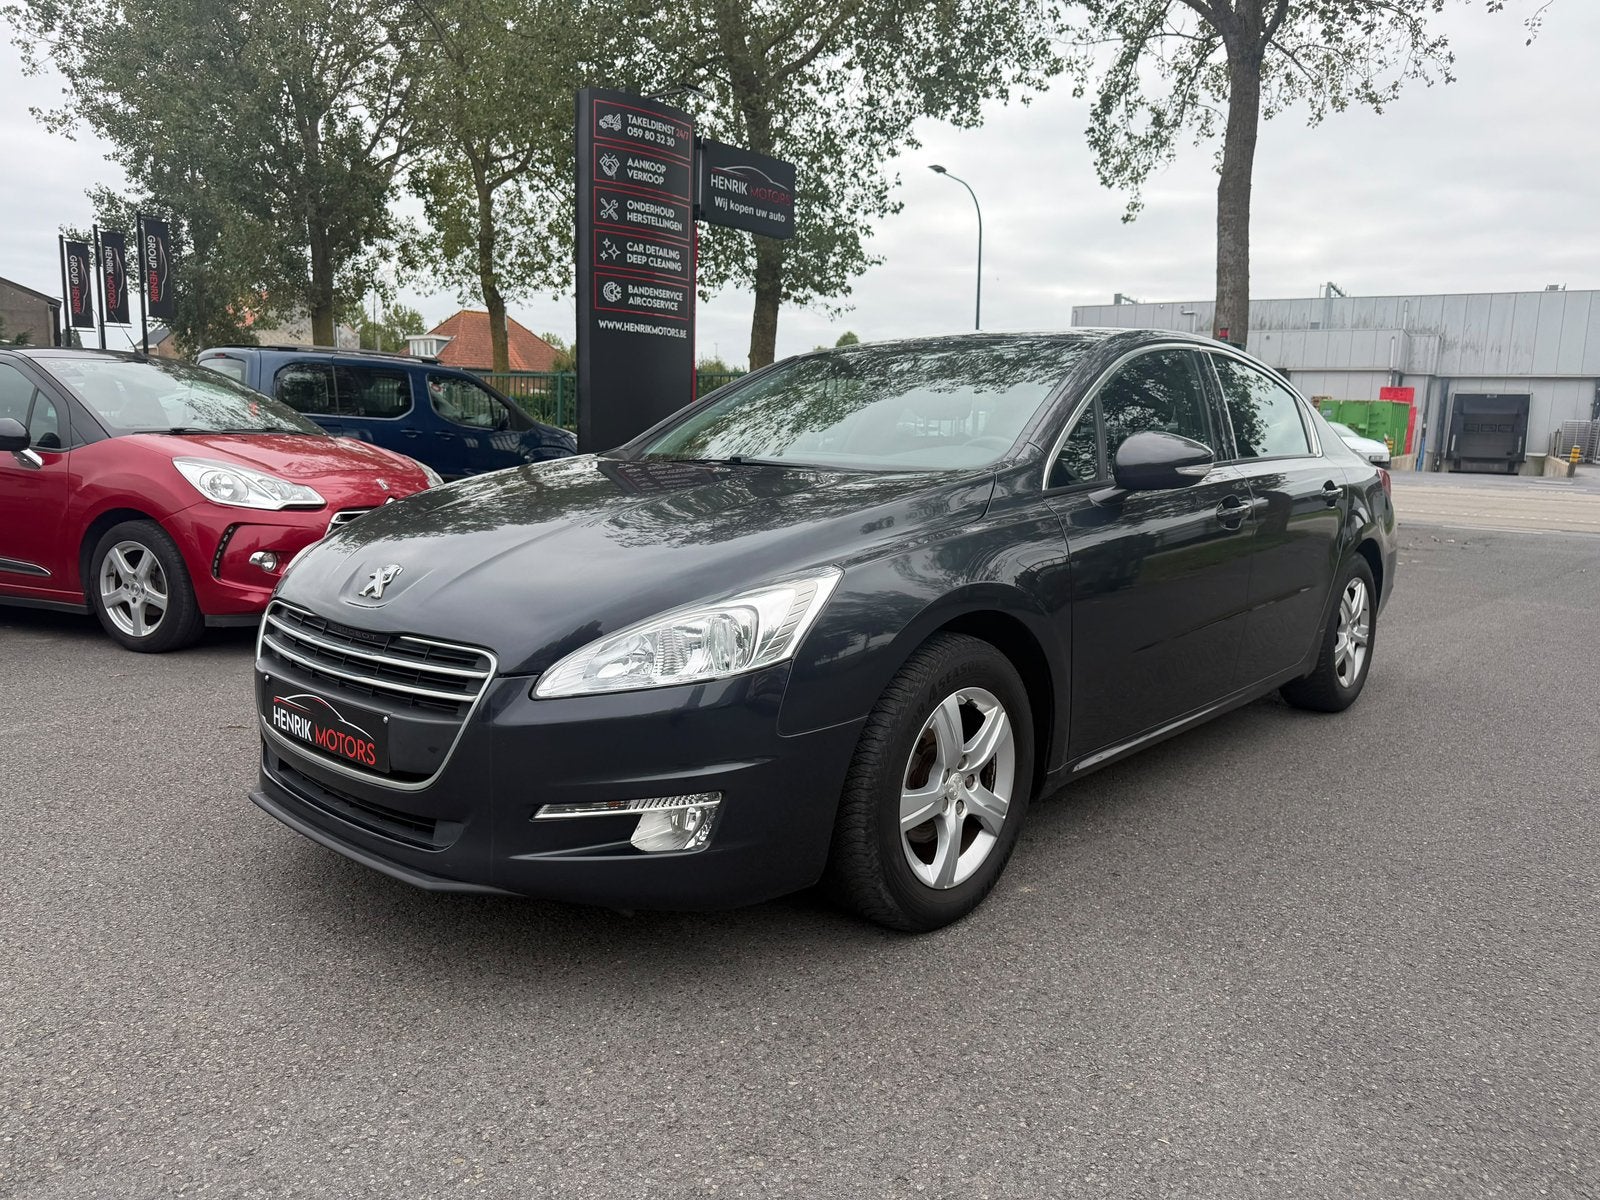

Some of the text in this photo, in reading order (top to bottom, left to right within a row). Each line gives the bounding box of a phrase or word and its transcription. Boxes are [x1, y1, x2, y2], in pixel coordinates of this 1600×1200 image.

[627, 114, 689, 140] TAKELDIENST 24/7
[627, 126, 675, 147] 059 80 32 30
[627, 157, 667, 174] AANKOOP
[627, 168, 664, 185] VERKOOP
[710, 174, 792, 206] HENRIK MOTORS
[626, 200, 675, 218] ONDERHOUD
[714, 196, 786, 222] Wij kopen uw auto
[626, 211, 682, 231] HERSTELLINGEN
[626, 242, 680, 260] CAR DETAILING
[147, 234, 159, 303] GROUP HENRIK
[627, 253, 682, 272] DEEP CLEANING
[69, 254, 81, 314] GROUP HENRIK
[105, 246, 117, 310] HENRIK MOTORS
[628, 284, 683, 301] BANDENSERVICE
[628, 296, 678, 311] AIRCOSERVICE
[598, 319, 687, 338] WWW.HENRIKMOTORS.BE
[273, 705, 376, 765] HENRIK MOTORS
